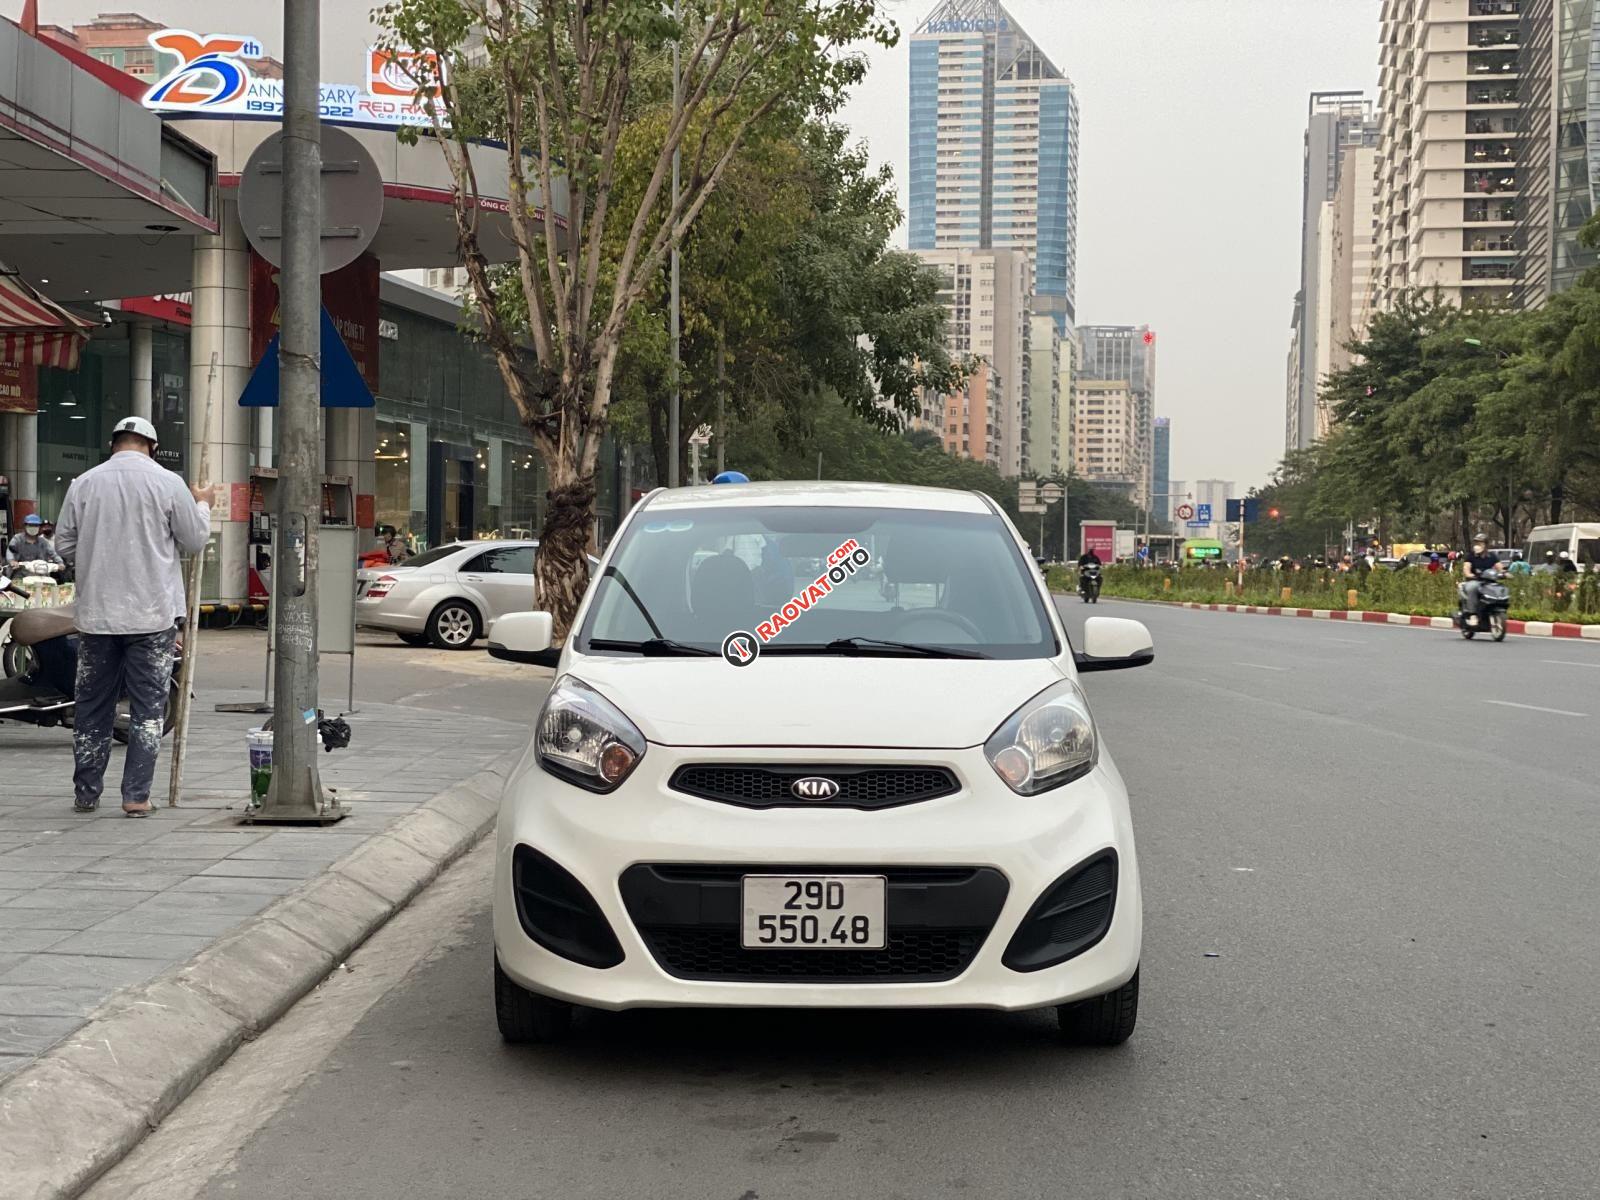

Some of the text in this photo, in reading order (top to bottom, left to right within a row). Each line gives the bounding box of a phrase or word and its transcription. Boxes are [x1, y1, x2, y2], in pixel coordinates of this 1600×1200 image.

[248, 83, 356, 104] ANNSARY
[319, 105, 354, 118] 022
[359, 101, 449, 118] RED RIV
[798, 781, 832, 796] KIA
[784, 881, 844, 910] 29D
[758, 915, 870, 944] 550.48
